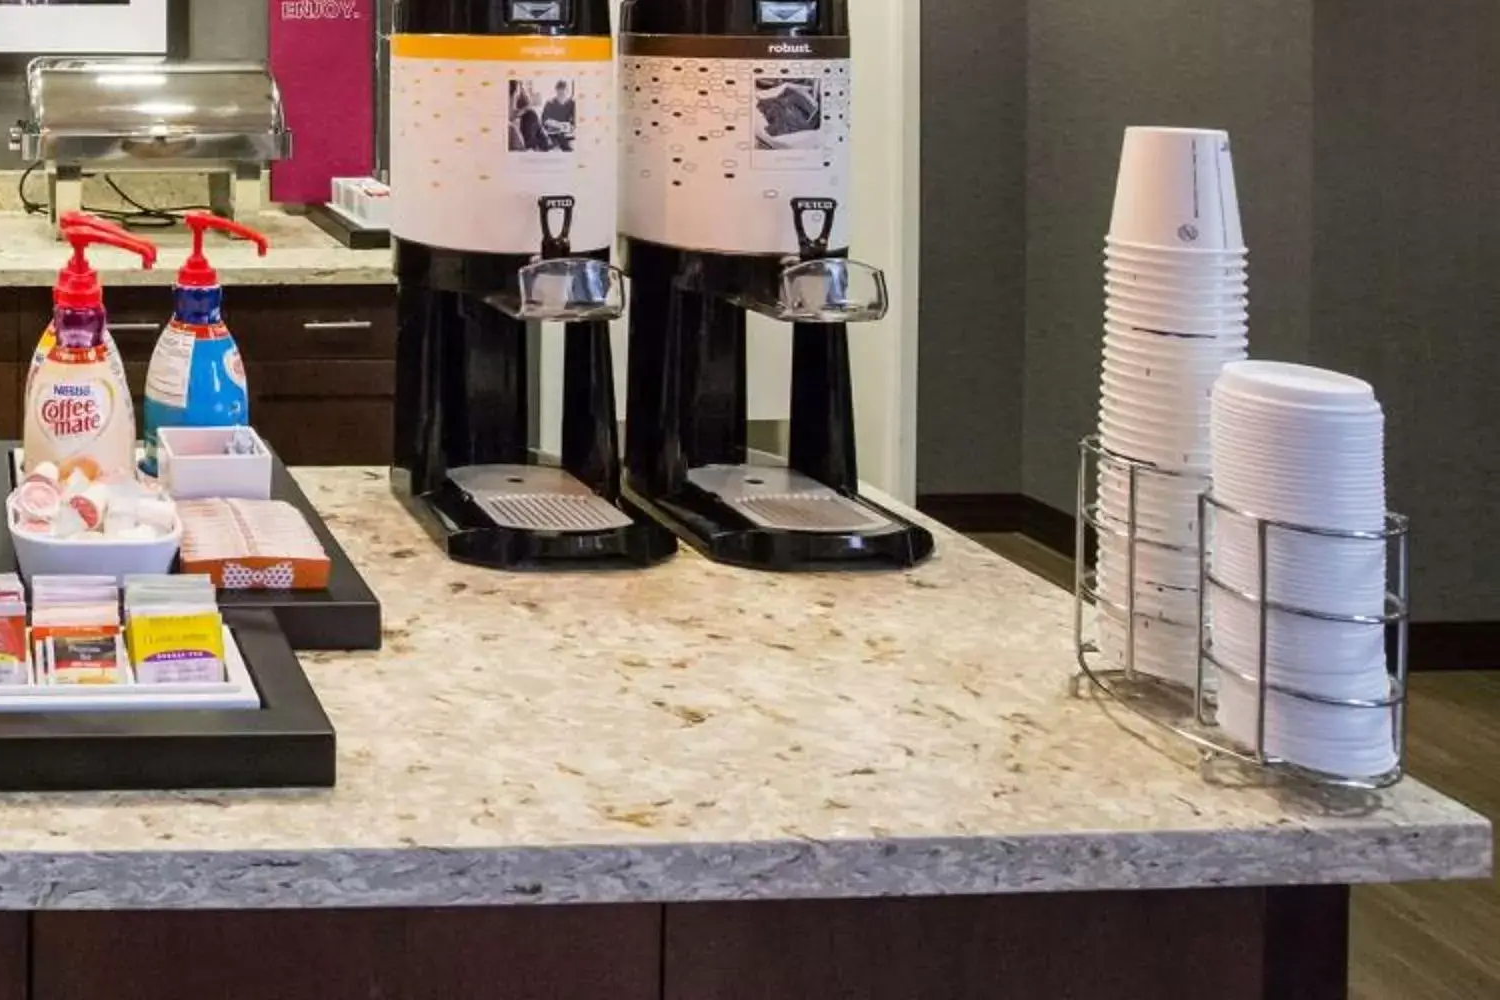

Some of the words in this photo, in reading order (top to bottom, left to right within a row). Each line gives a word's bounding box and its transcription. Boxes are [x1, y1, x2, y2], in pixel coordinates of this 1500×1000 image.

[768, 41, 812, 53] robust.
[41, 399, 96, 422] Coffee
[54, 414, 101, 437] mate
